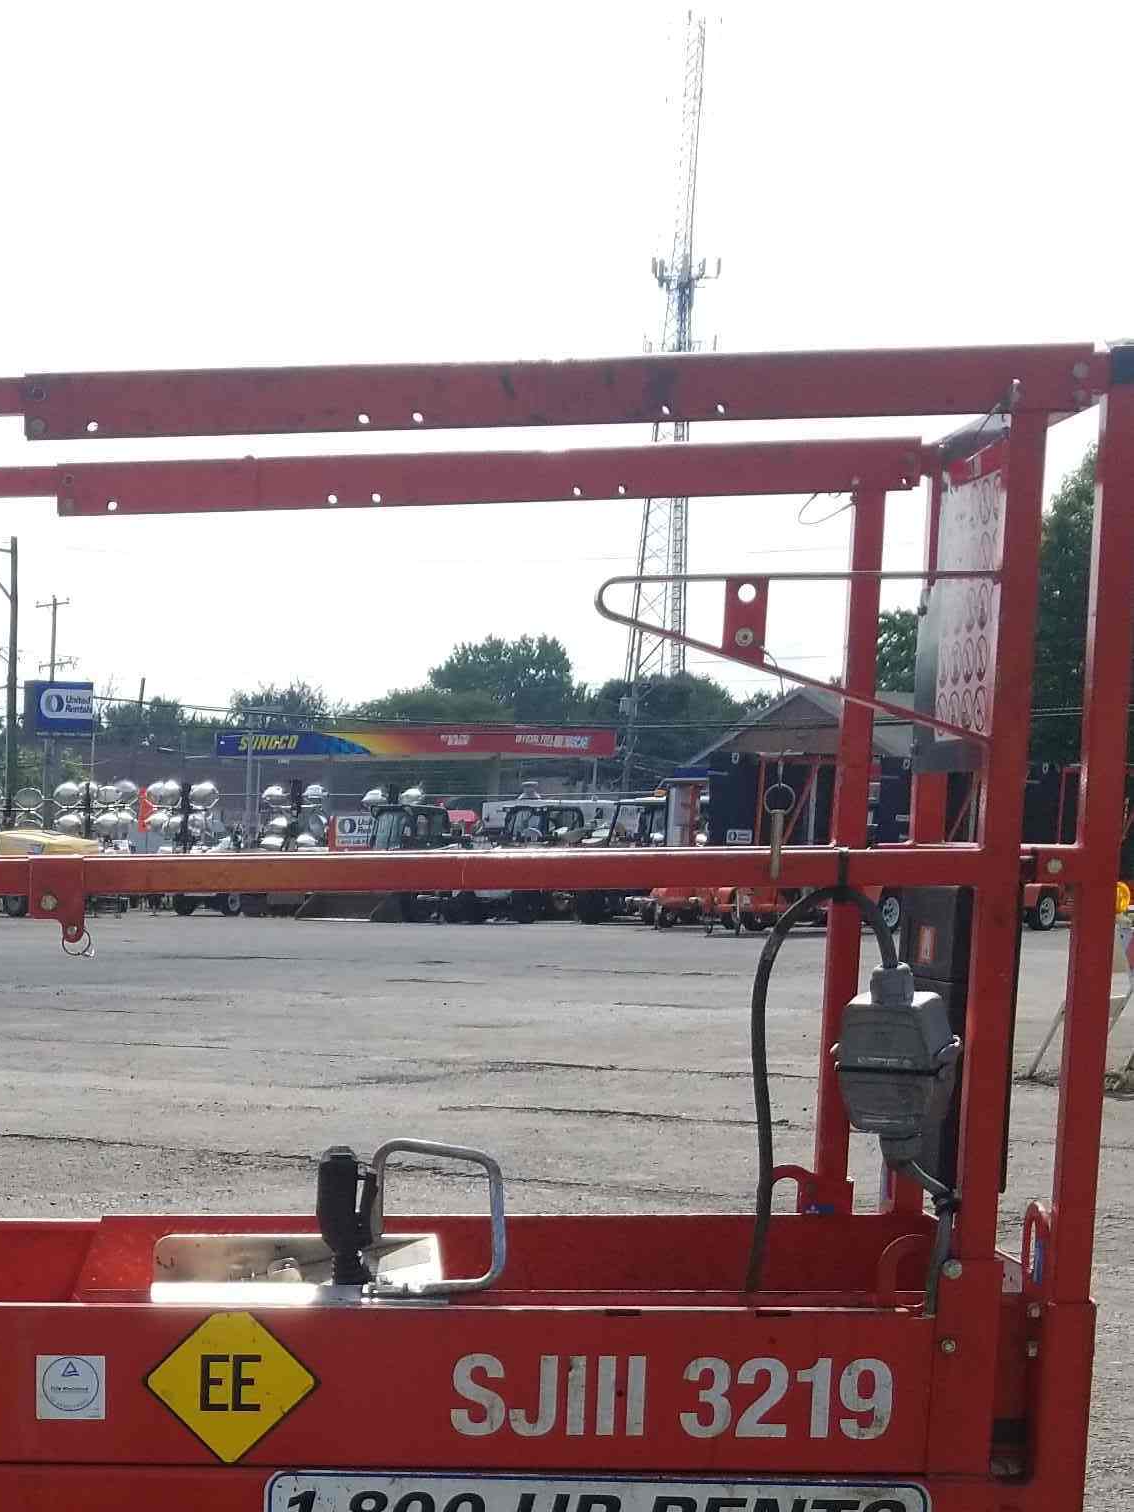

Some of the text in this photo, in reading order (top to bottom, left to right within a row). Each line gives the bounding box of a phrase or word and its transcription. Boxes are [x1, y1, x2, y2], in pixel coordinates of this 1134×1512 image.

[66, 695, 91, 704] United
[238, 734, 299, 751] SUNOCO
[200, 1354, 262, 1412] EE
[450, 1353, 894, 1440] SJIII 3219
